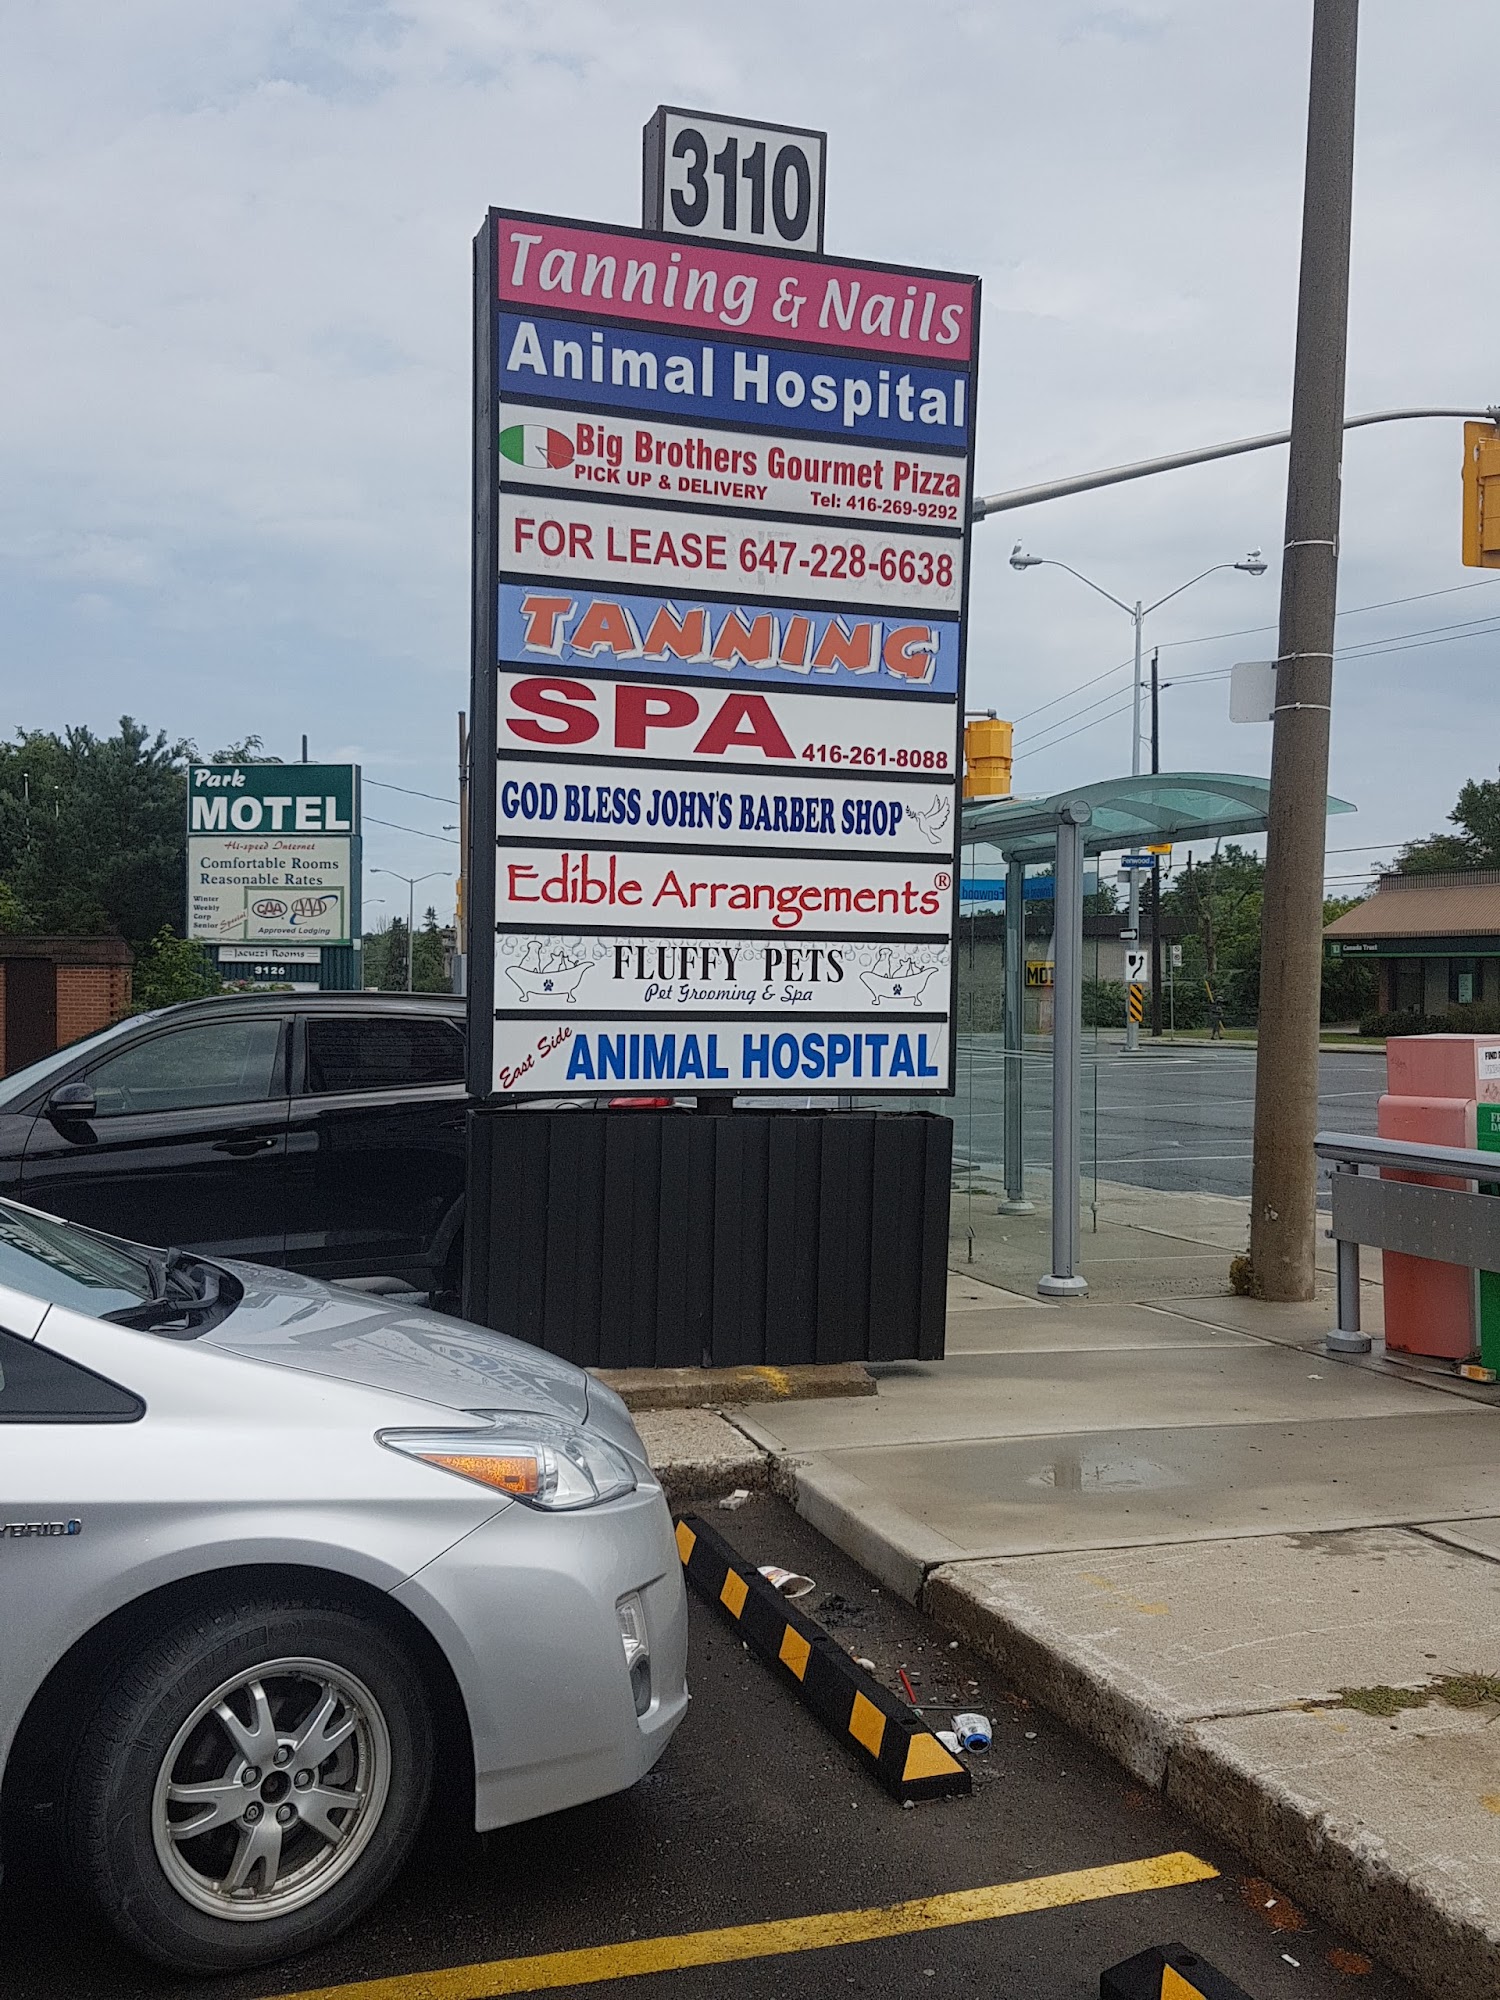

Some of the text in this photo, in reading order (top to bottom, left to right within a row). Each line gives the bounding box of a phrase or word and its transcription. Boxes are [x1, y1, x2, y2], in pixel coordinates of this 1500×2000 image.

[670, 128, 811, 242] 3110
[509, 232, 964, 345] Tanning & Nails
[506, 322, 966, 428] Animal Hospital
[576, 423, 961, 498] Big Brothers Gourmet Pizza
[574, 464, 768, 501] PICK UP & DELIVERY
[811, 491, 958, 520] Tel: 416-269-9292
[515, 517, 953, 587] FOR LEASE 647-228-6638
[520, 594, 938, 684] TANNING
[506, 677, 949, 770] SPA 416-261-8088
[194, 769, 246, 787] Park
[192, 796, 350, 830] MOTEL
[501, 781, 902, 837] GOD BLESS JOHN'S BARBER SHOP
[224, 841, 316, 853] Hi-speed Internet
[1121, 856, 1150, 865] Fenwood
[201, 856, 339, 870] Comfortable Rooms
[507, 852, 642, 905] Edible
[201, 873, 323, 885] Reasonable Rates
[193, 913, 211, 921] Corp
[220, 911, 246, 930] Special
[256, 901, 283, 915] CAA
[294, 897, 324, 916] AAA
[258, 927, 331, 935] Approved Lodging
[234, 948, 305, 958] Jacuzzi Rooms
[612, 945, 844, 983] FLUFFY PETS
[254, 966, 285, 975] 3126
[644, 983, 813, 1005] Pet Grooming & Spa
[499, 1025, 573, 1089] East Side
[566, 1033, 939, 1081] ANIMAL HOSPITAL
